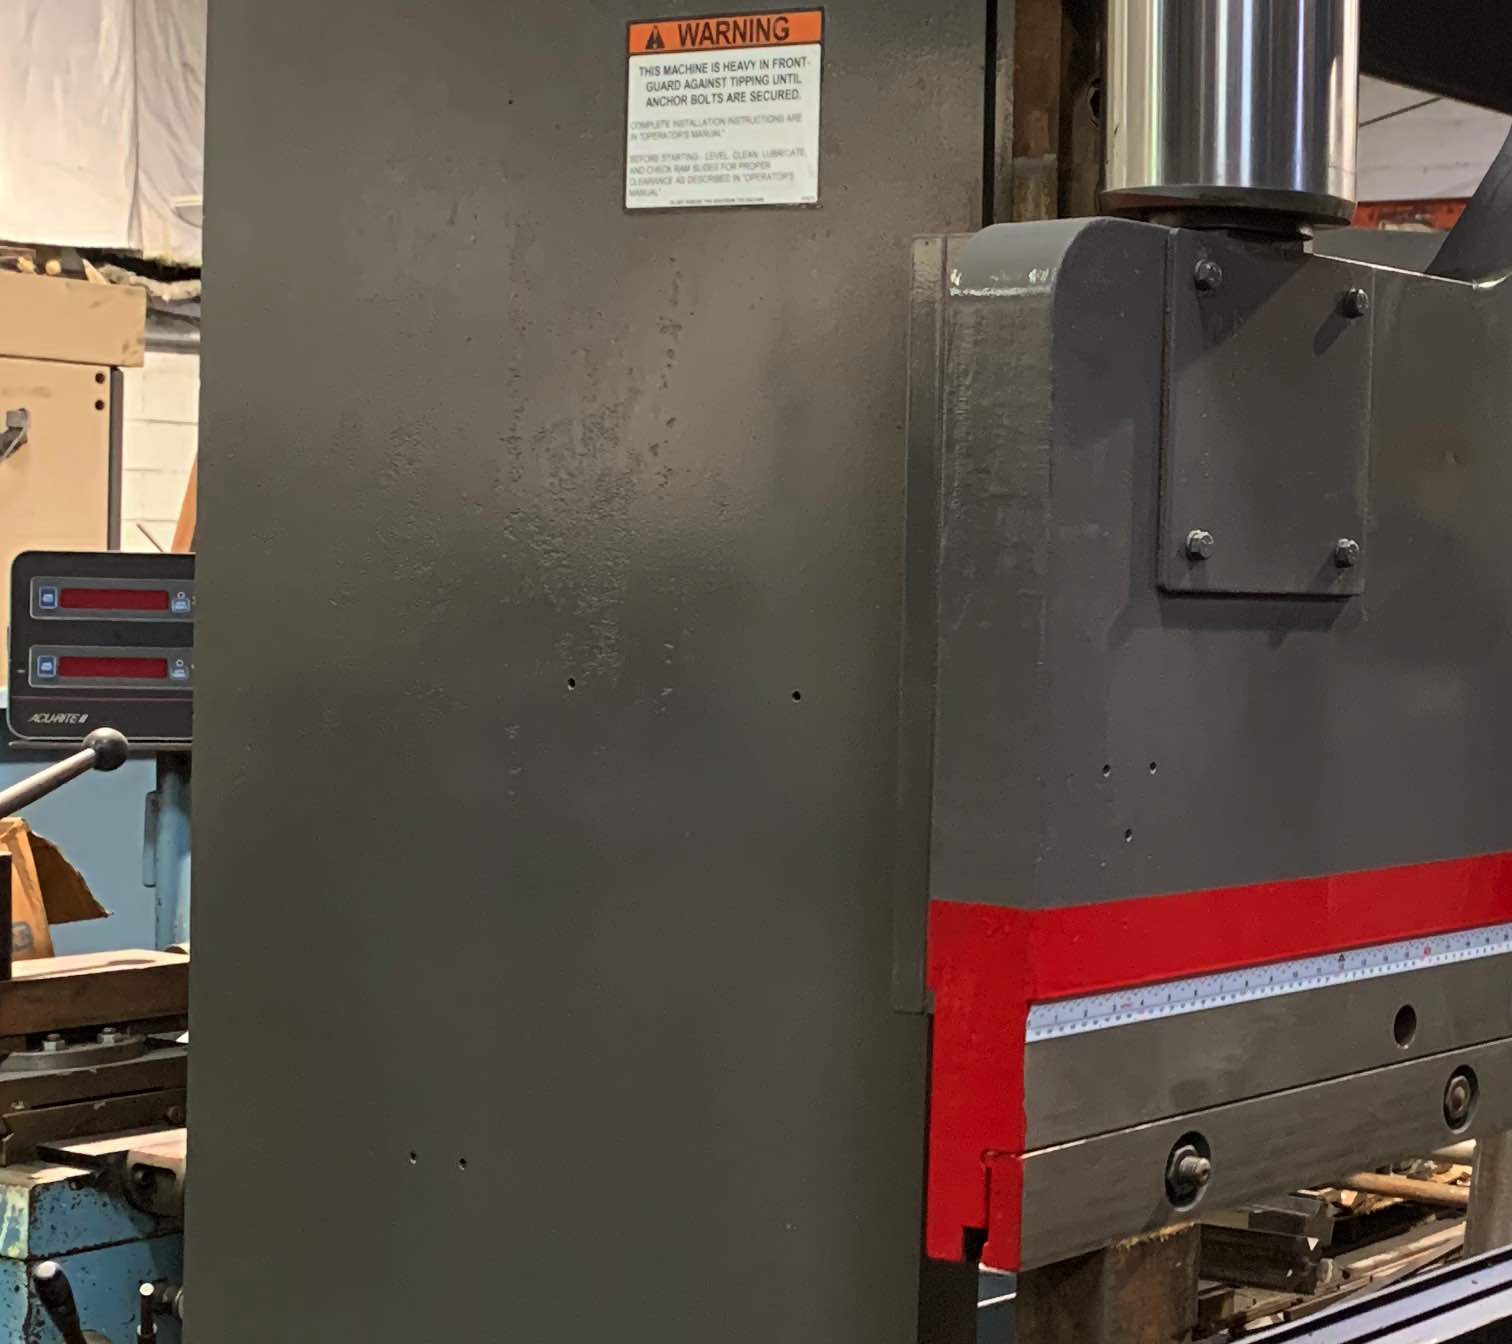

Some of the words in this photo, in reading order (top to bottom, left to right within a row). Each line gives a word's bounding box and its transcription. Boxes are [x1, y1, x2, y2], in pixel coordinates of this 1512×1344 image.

[678, 16, 790, 47] WARNING
[639, 66, 660, 77] THIS
[663, 63, 708, 76] MACHINE
[711, 62, 721, 73] IS
[723, 60, 756, 72] HEAVY
[759, 58, 770, 69] IN
[646, 80, 681, 92] GUARD
[684, 77, 727, 90] AGAINST
[731, 75, 770, 88] TIPPING
[773, 73, 802, 85] UNTIL
[646, 95, 688, 107] ANCHOR
[691, 93, 724, 105] BOLTS
[726, 91, 746, 103] ARE
